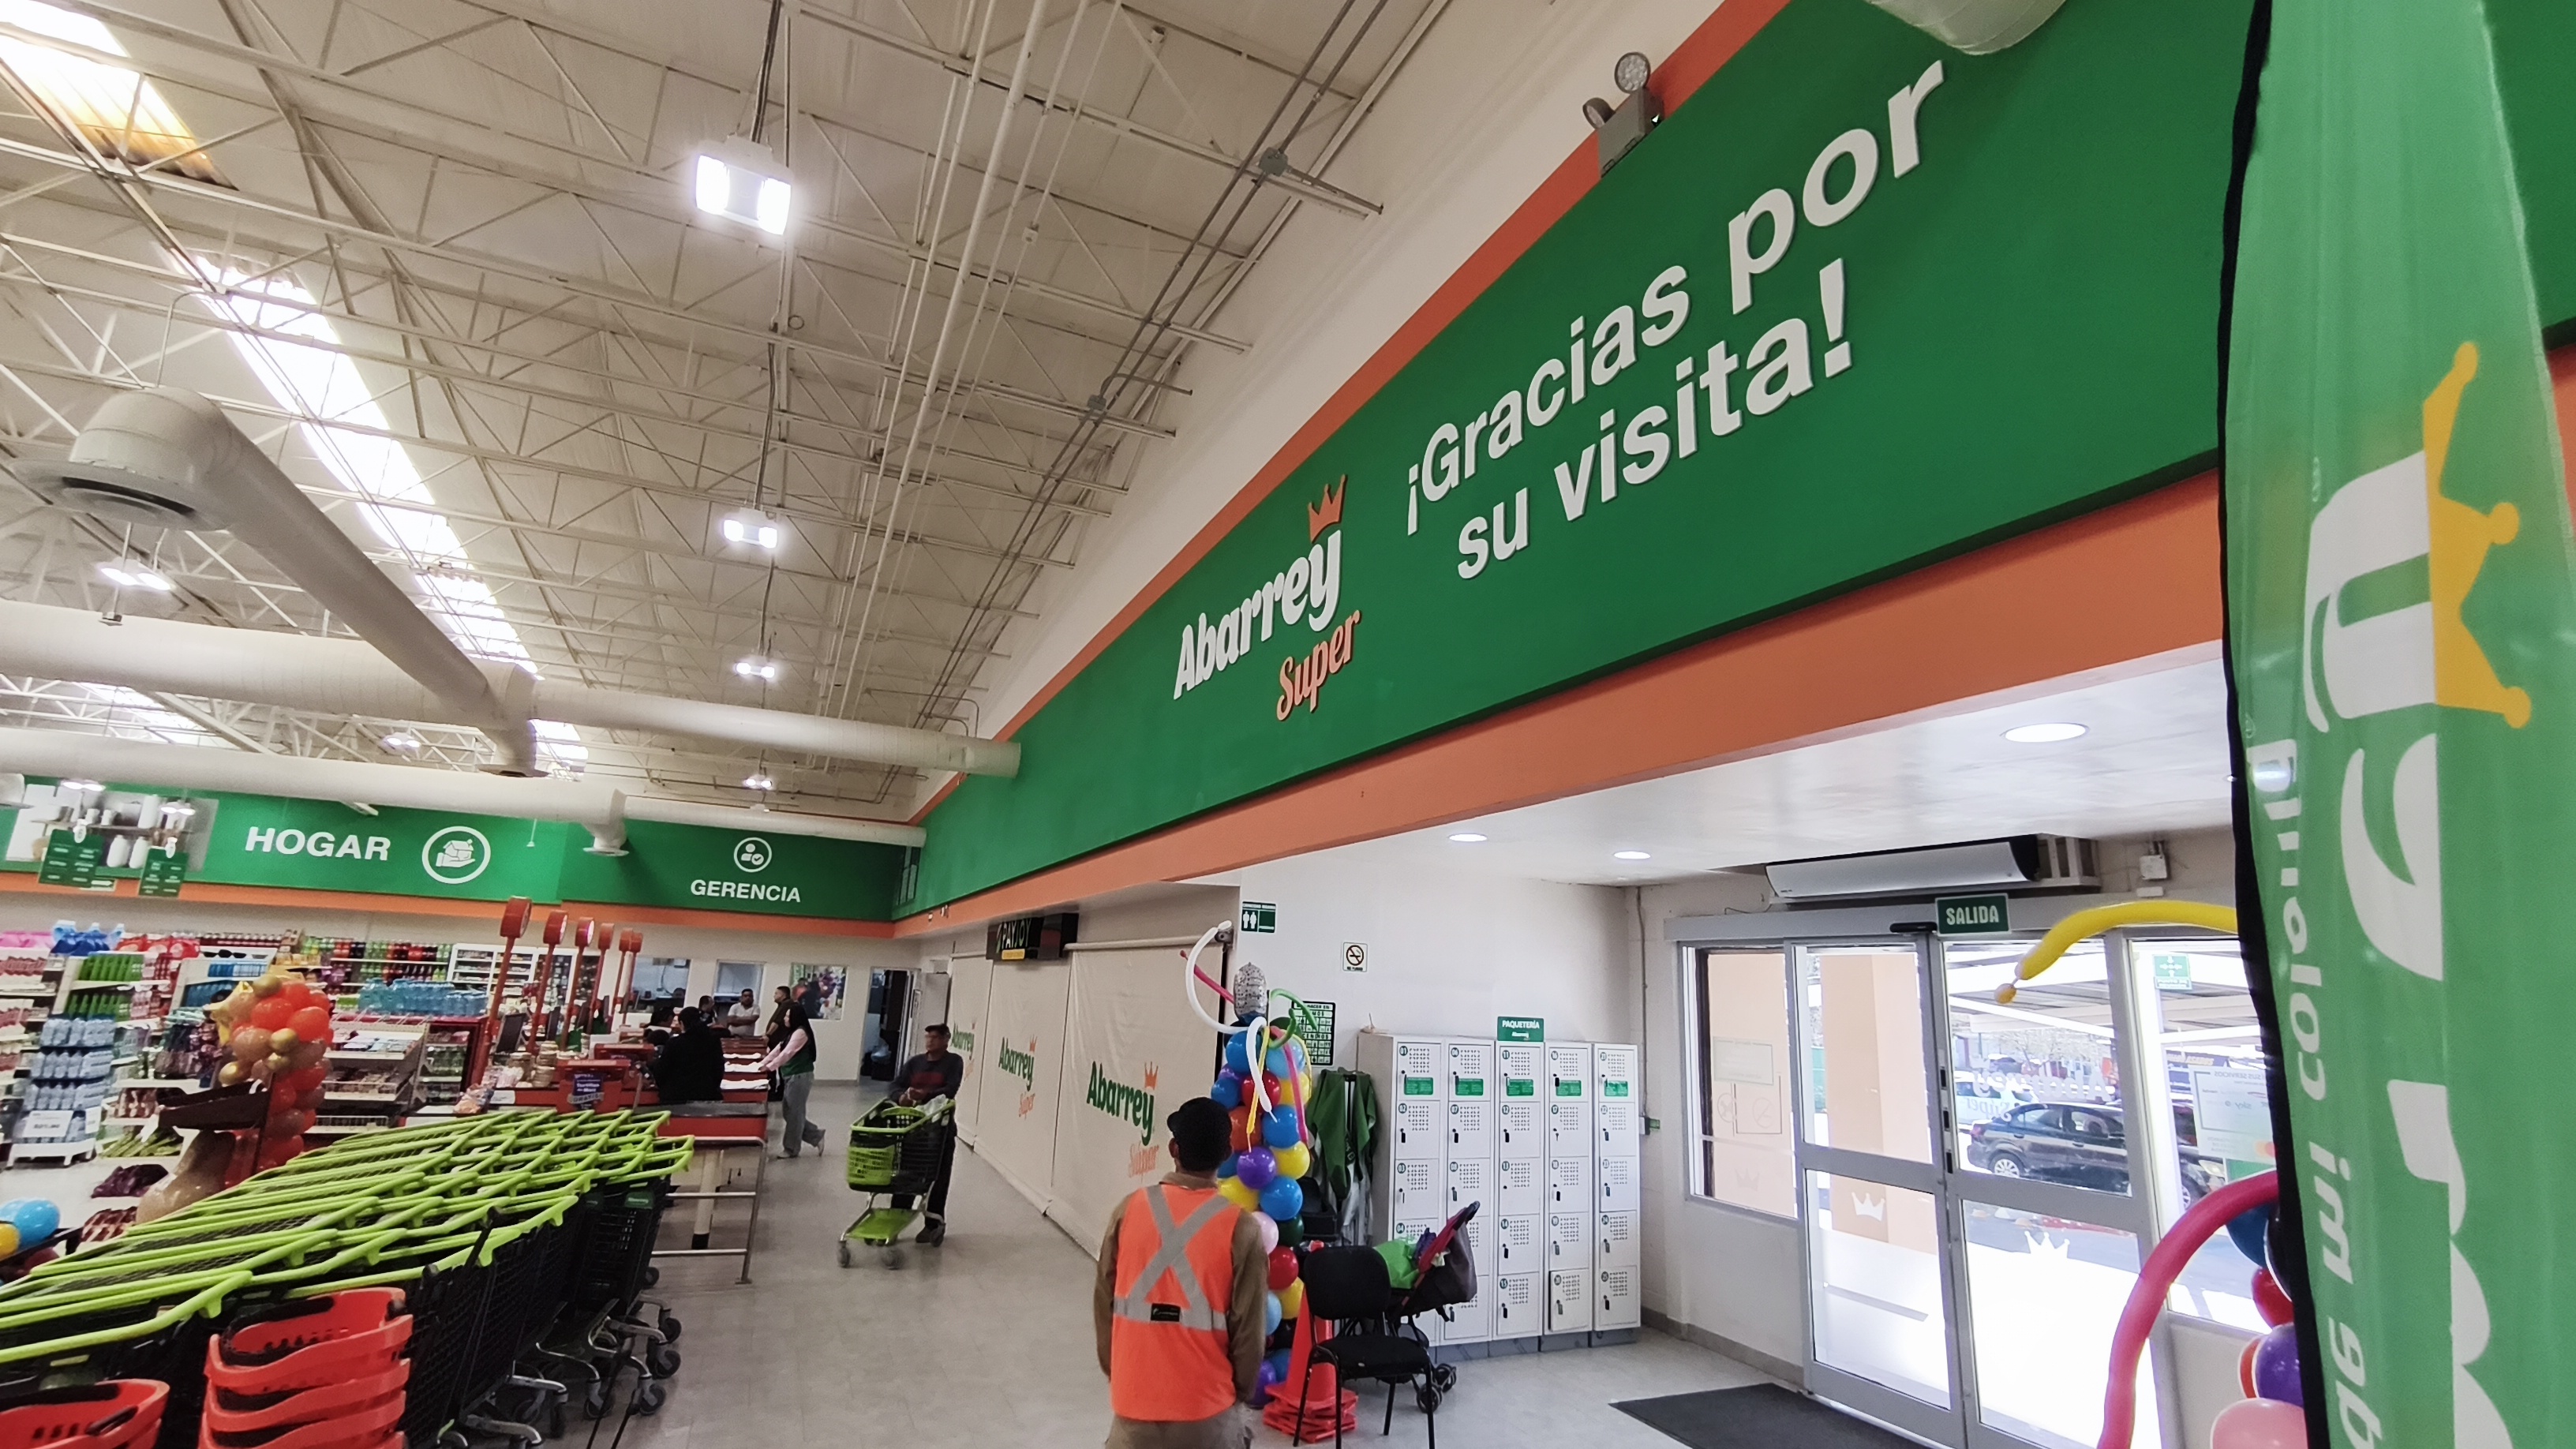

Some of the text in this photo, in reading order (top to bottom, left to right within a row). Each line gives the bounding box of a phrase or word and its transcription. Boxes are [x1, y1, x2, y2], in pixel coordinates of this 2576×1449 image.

[1407, 59, 1944, 536] ¡Gracias por
[1458, 257, 1852, 579] su visita!
[1173, 530, 1341, 700] Abarrey
[1277, 609, 1361, 721] Super
[245, 826, 391, 861] HOGAR
[691, 879, 800, 903] GERENCIA
[1945, 905, 1999, 925] SALIDA
[998, 1036, 1034, 1092] Abarrey
[1086, 1060, 1155, 1147] Abarrey
